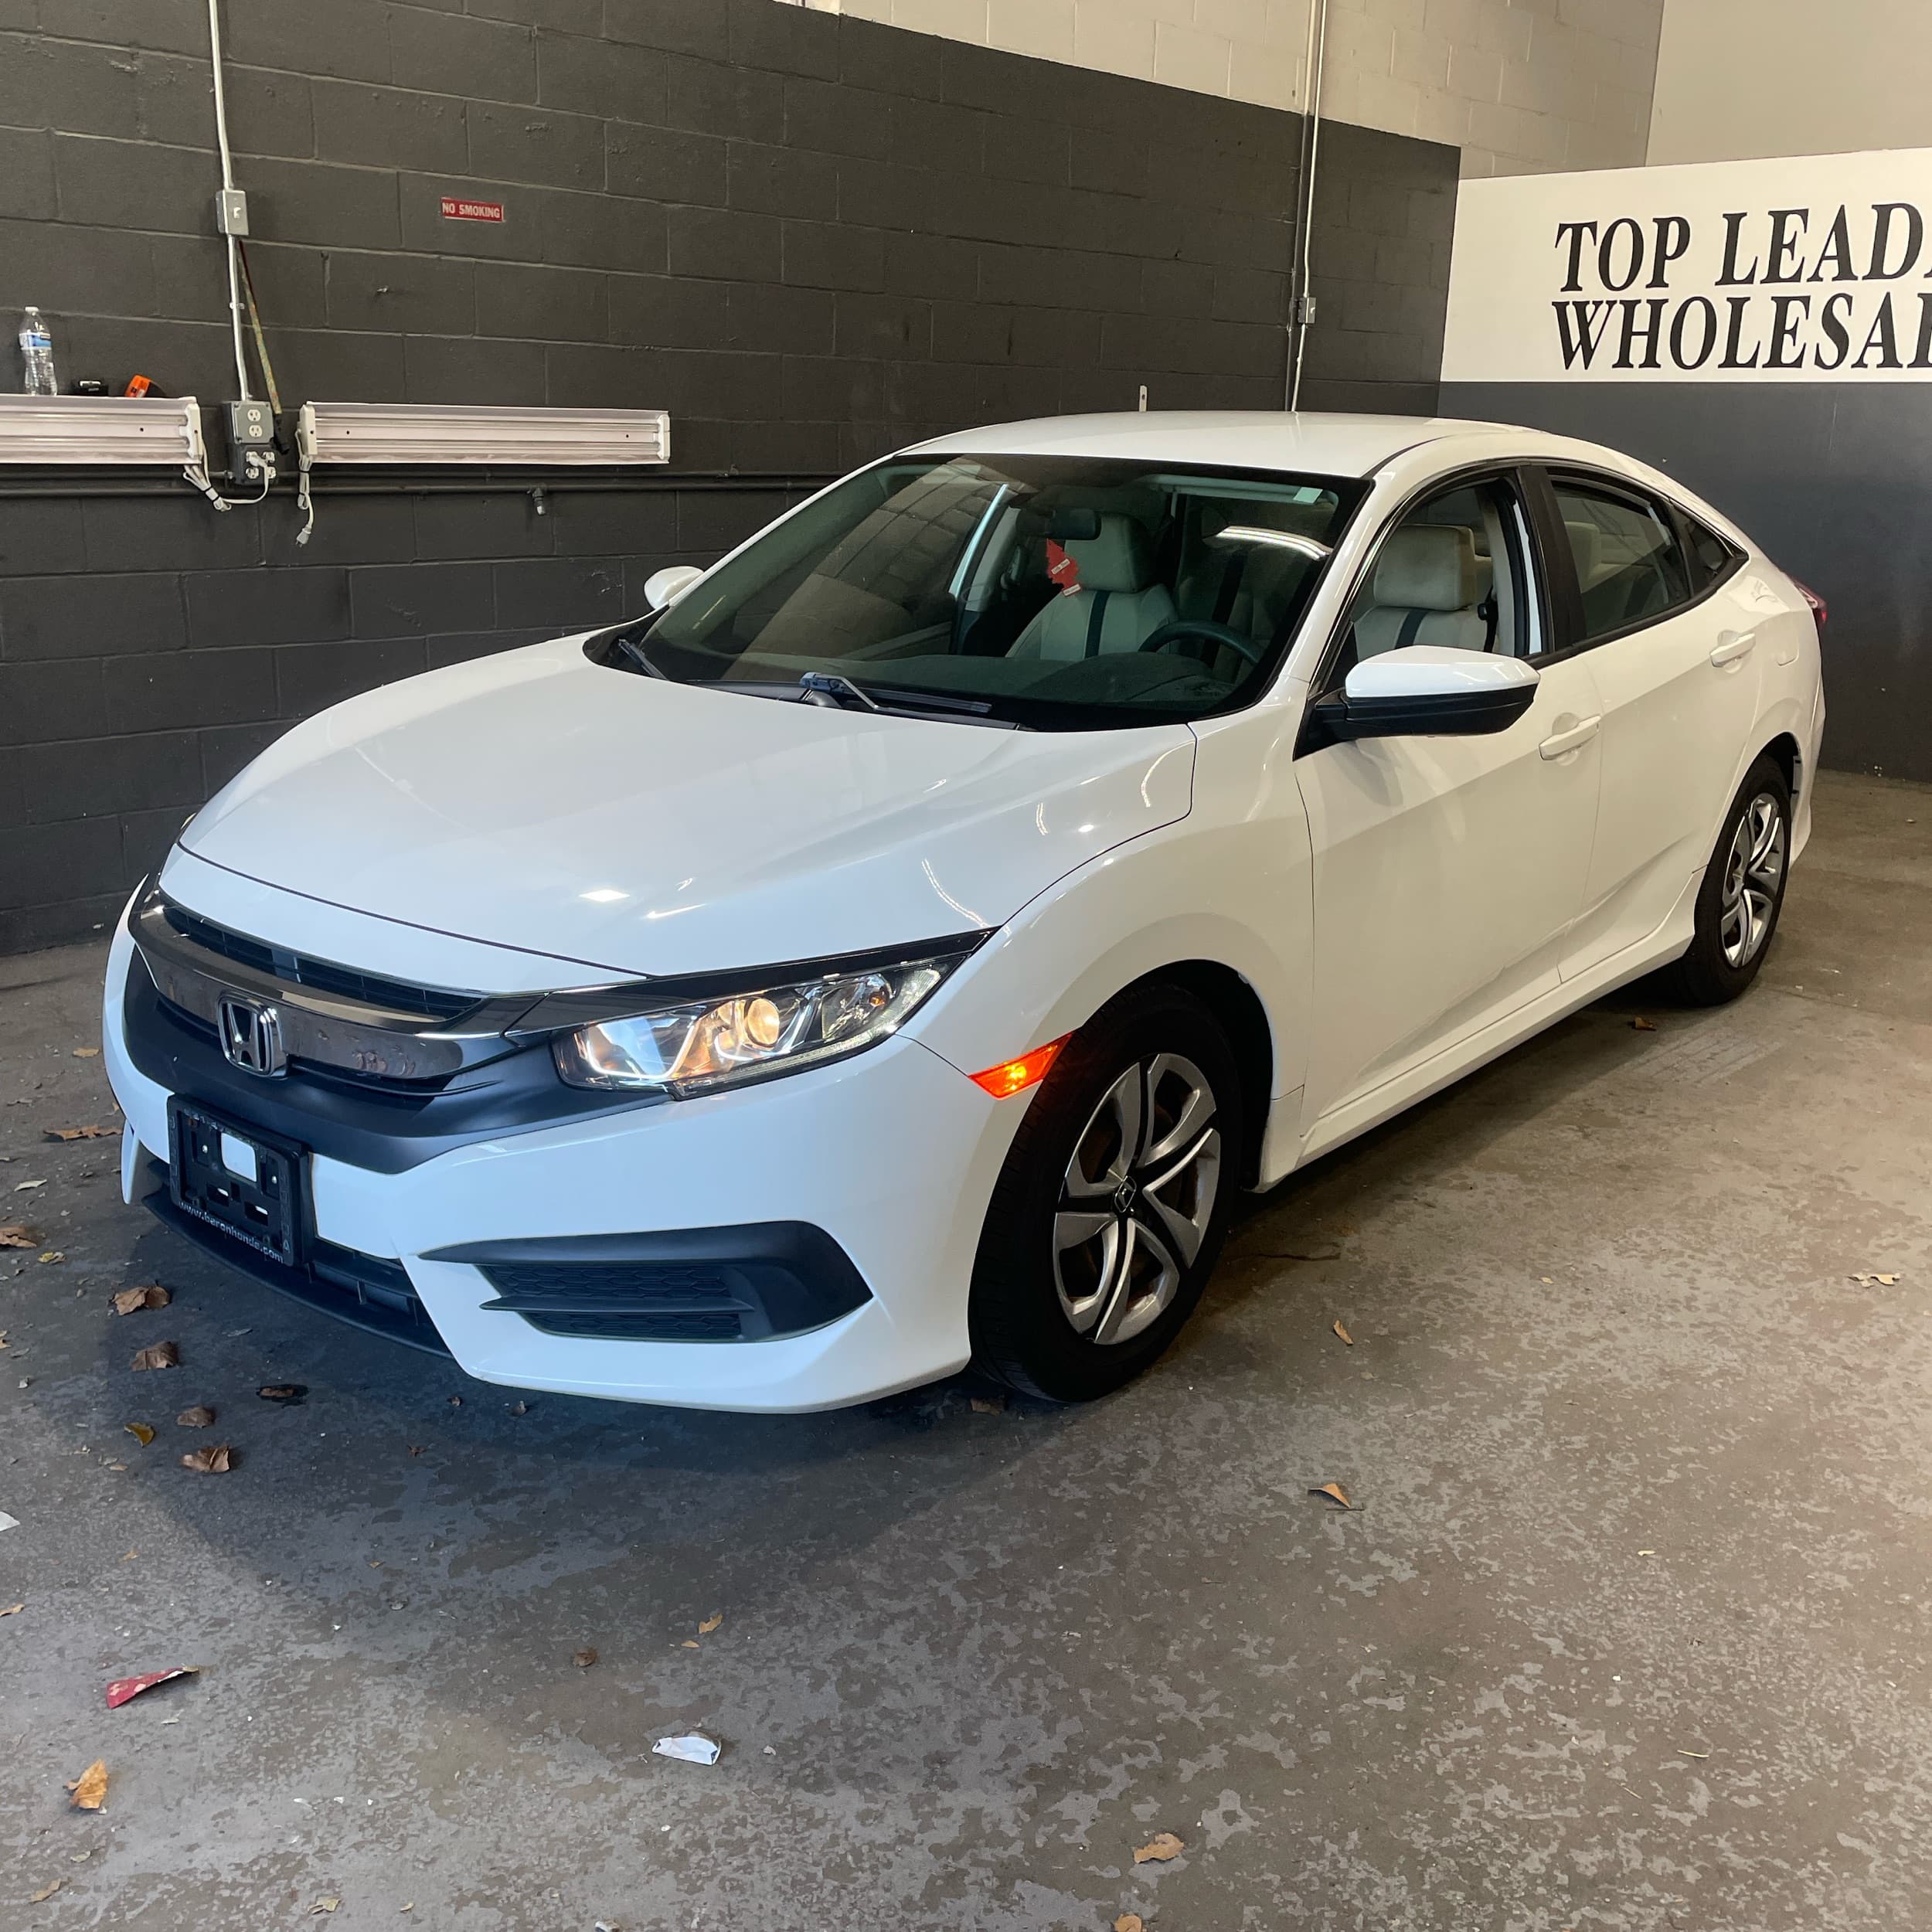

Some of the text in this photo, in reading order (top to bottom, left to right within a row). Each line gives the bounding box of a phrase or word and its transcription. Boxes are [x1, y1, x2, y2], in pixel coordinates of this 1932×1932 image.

[442, 202, 500, 218] NO SMOKING
[1555, 202, 1932, 292] TOP LEAD
